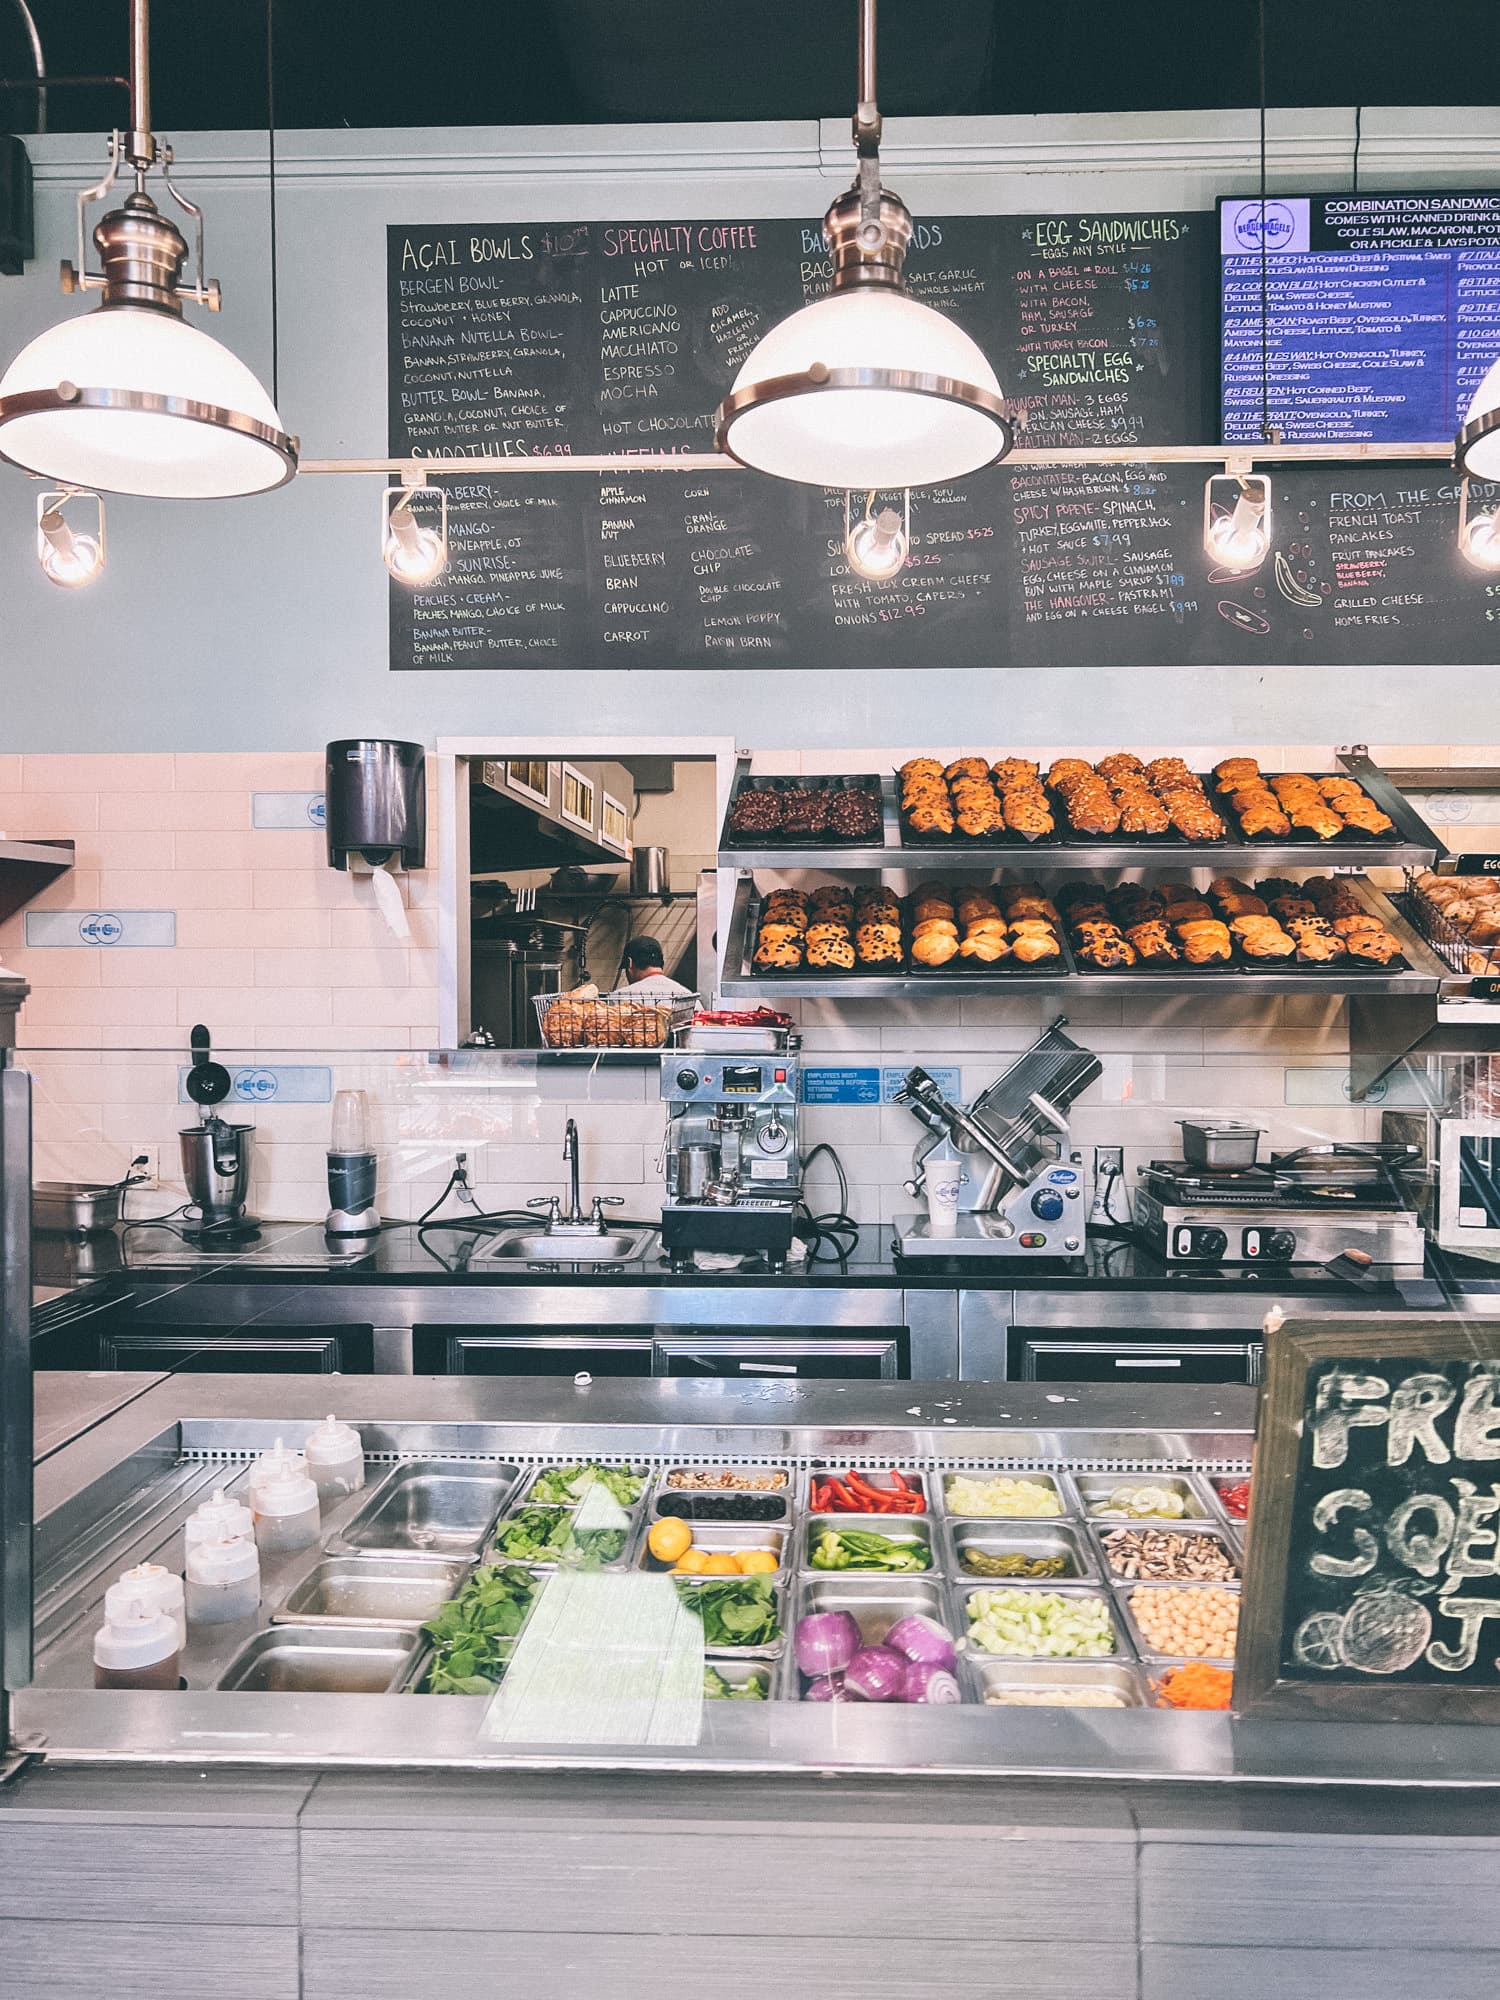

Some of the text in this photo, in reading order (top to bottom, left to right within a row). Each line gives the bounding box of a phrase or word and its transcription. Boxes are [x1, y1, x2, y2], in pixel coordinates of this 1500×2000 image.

[1325, 199, 1429, 212] COMBINATION
[1325, 213, 1491, 225] COMES WITH CANNED DRINK
[1036, 218, 1180, 247] EGG SANDWICHES
[1337, 228, 1370, 237] COLE
[603, 225, 758, 256] SPECIALTY COFFEE
[1350, 238, 1467, 249] OR A PICKLE LAYS
[402, 235, 534, 272] AÇAI BOWLS
[1042, 243, 1127, 259] EGGS ANY STYLE
[634, 259, 669, 278] HOT
[938, 268, 977, 281] GARLIC
[1016, 265, 1119, 281] ON BAGEL ROLL
[400, 276, 454, 297] BERGEN
[601, 284, 639, 304] LATTE
[952, 282, 985, 293] WHEAT
[1019, 279, 1098, 294] WITH CHEESE
[1020, 298, 1046, 308] WITH
[600, 303, 677, 324] CAPPUCCINO
[711, 304, 729, 318] ADD
[1049, 309, 1094, 320] SAUSAGE
[402, 310, 512, 328] COCONUT HONEY
[1040, 320, 1078, 333] TURKEY
[602, 321, 681, 341] AMERICANO
[401, 329, 514, 349] BANANA NUTELLA
[1044, 338, 1108, 350] TURKEY BACON
[601, 340, 679, 360] MACCHIATO
[1027, 351, 1134, 373] SPECIALTY EGG
[604, 364, 675, 381] ESPRESSO
[1042, 368, 1130, 387] SANDWICHES
[401, 390, 449, 408] BUTTER
[600, 383, 658, 401] MOCHA
[1098, 392, 1129, 404] EGGS
[511, 404, 549, 416] CHOICE
[407, 418, 564, 437] PEANUT BUTTER NUT BUTTER
[602, 421, 632, 436] HOT
[1067, 419, 1107, 431] CHEESE
[1104, 431, 1138, 445] EGGS
[1125, 470, 1167, 482] EGG AND
[454, 485, 493, 500] BERRY
[599, 494, 647, 505] CINNAMON
[601, 487, 625, 497] APPLE
[684, 488, 710, 498] CORN
[933, 489, 954, 498] TOFU
[1013, 489, 1047, 501] CHEESE
[1330, 492, 1387, 509] FROM
[1396, 489, 1430, 503] THE
[1014, 504, 1049, 524] SPICY
[1329, 511, 1422, 528] FRENCH TOAST
[601, 519, 635, 531] BANANA
[686, 520, 728, 534] ORANGE
[1112, 516, 1172, 530] PEPPER JACK
[601, 531, 620, 541] NUT
[926, 531, 965, 545] SPREAD
[1329, 529, 1394, 544] PANCAKES
[1028, 537, 1087, 554] HOT SAUCE
[604, 551, 666, 569] BLUEBERRY
[690, 544, 754, 563] CHOCOLATE
[1331, 546, 1416, 562] FRUIT PANCAKES
[693, 562, 721, 576] CHIP
[830, 565, 851, 577] LOX
[1021, 555, 1072, 573] SAUSAGE
[490, 568, 564, 583] PINEAPPLE JUICE
[1047, 562, 1174, 582] CHEESE CINNAMON
[606, 576, 638, 590] BRAN
[699, 580, 782, 595] DOUBLE CHOCOLATE
[831, 574, 993, 596] FRESH LOX CREAM CHEESE
[1025, 576, 1153, 597] BUN WITH MAPLE SYRUP
[413, 592, 504, 607] PEACHES CREAM
[700, 594, 722, 603] CHIP
[834, 591, 965, 609] WITH CAPERS
[1024, 588, 1174, 611] THE HANGOVER PASTRAMI
[1334, 593, 1424, 609] GRILLED CHEESE
[486, 602, 565, 617] CHOICE MILK
[604, 601, 670, 614] CAPPUCCINO
[1026, 603, 1166, 623] AND EGG CHEESE BAGEL
[704, 612, 781, 628] LEMON POPPY
[835, 612, 878, 625] ONIONS
[413, 628, 450, 641] BANANA
[603, 630, 650, 642] CARROT
[705, 634, 772, 648] RAISIN BRAN
[453, 638, 559, 651] PEANUT CHOICE
[429, 652, 454, 663] MILK
